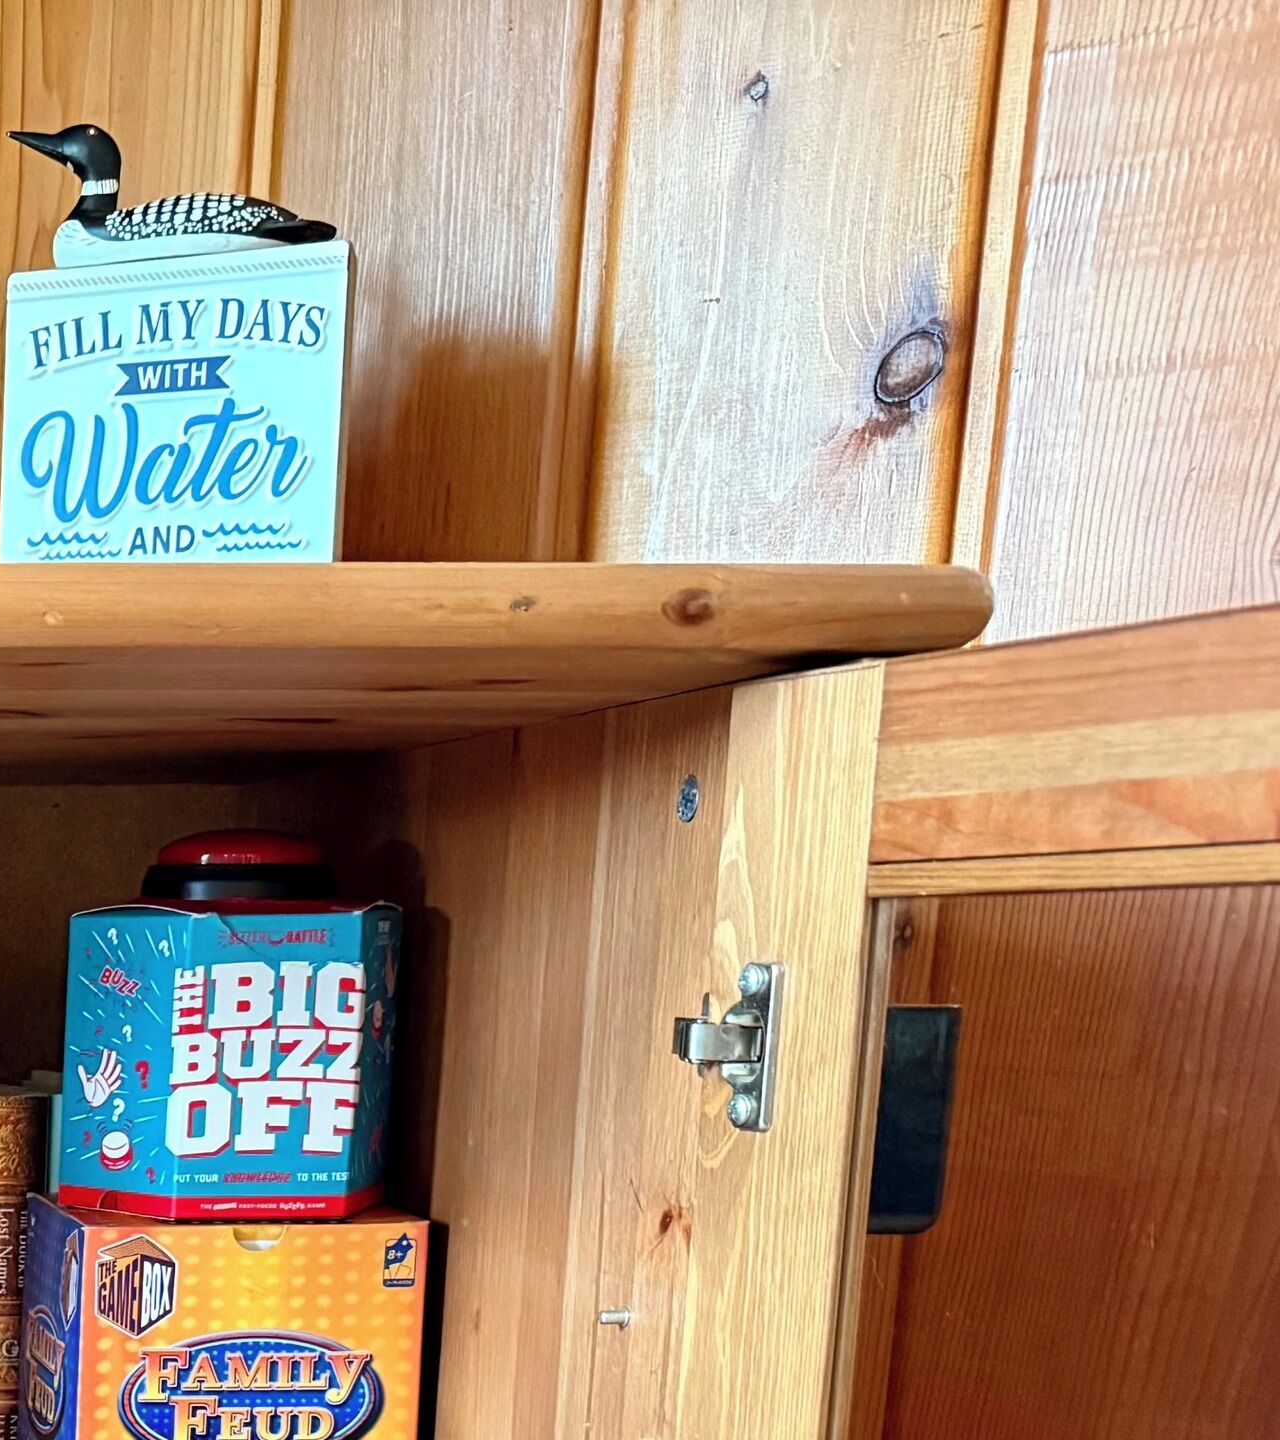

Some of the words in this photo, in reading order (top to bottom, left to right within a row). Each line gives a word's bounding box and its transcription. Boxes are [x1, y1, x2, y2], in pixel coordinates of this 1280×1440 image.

[28, 310, 124, 370] FILL
[138, 298, 206, 345] MY
[215, 298, 327, 348] DAYS
[136, 361, 208, 390] WITH
[19, 397, 310, 524] Water
[128, 524, 196, 556] AND
[98, 965, 141, 998] BUZZ
[172, 964, 206, 1034] THE
[207, 960, 367, 1031] BIG
[168, 1028, 363, 1086] BUZZ
[164, 1080, 360, 1157] OFF
[173, 1174, 191, 1183] PUT
[194, 1174, 219, 1183] YOUR
[312, 1173, 329, 1182] THE
[98, 1260, 118, 1282] THE
[387, 1249, 404, 1260] 8+
[99, 1256, 140, 1335] GAME
[140, 1260, 173, 1329] BOX
[138, 1347, 372, 1407] FAMILY
